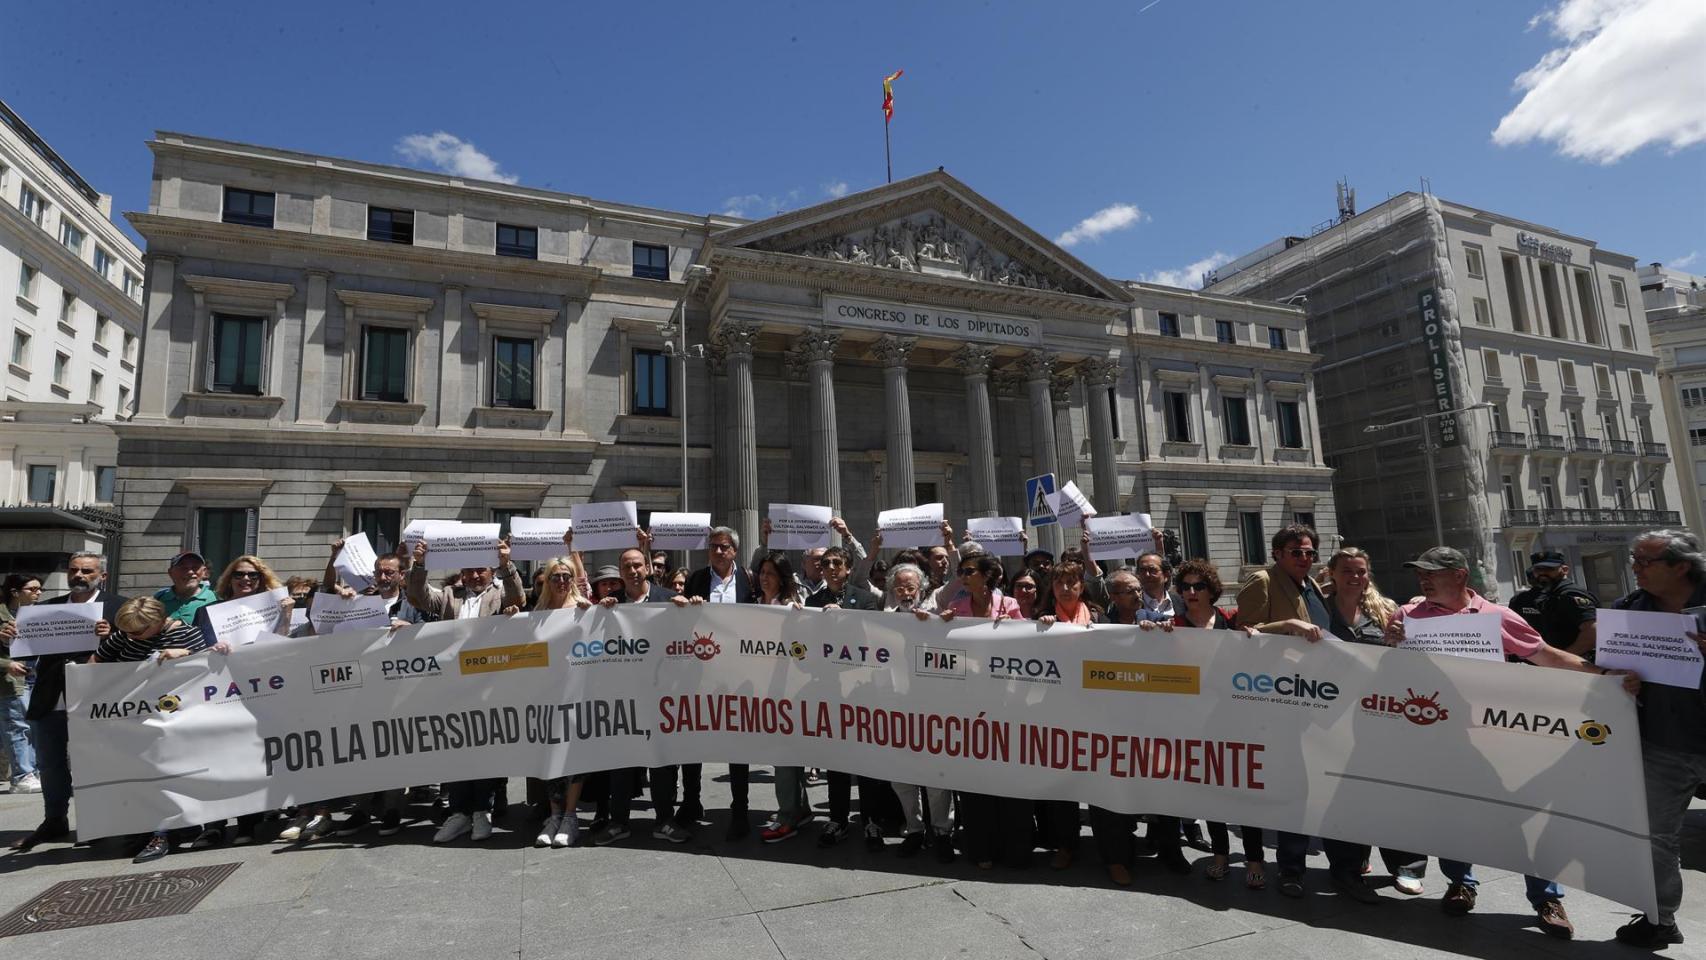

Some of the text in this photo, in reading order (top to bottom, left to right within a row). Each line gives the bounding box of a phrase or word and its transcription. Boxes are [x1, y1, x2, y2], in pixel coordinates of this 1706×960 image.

[838, 304, 1030, 337] CONGRESO DE LOS DIPUTADOS
[1422, 294, 1450, 411] PROLISER
[740, 639, 787, 657] MAPA
[1640, 634, 1684, 644] DIVERSIDAD
[1642, 643, 1681, 652] SALVEMOS
[666, 638, 721, 660] diboos
[1600, 647, 1700, 663] PRODUCCIÓN INDEPENDIENTE
[382, 656, 441, 676] PROA
[465, 654, 510, 667] PROFILM
[924, 652, 957, 670] PIAF
[989, 656, 1061, 678] PROA
[320, 666, 352, 684] PIAF
[1090, 670, 1145, 682] PROFILM
[90, 700, 152, 719] MAPA
[1270, 698, 1299, 706] estatal
[1361, 693, 1449, 724] diboos
[1482, 707, 1570, 737] MAPA
[264, 694, 1265, 790] POR LA DIVERSIDAD CULTURAL, SALVEMOS LA PRODUCCIÓN INDEPENDIENTE
